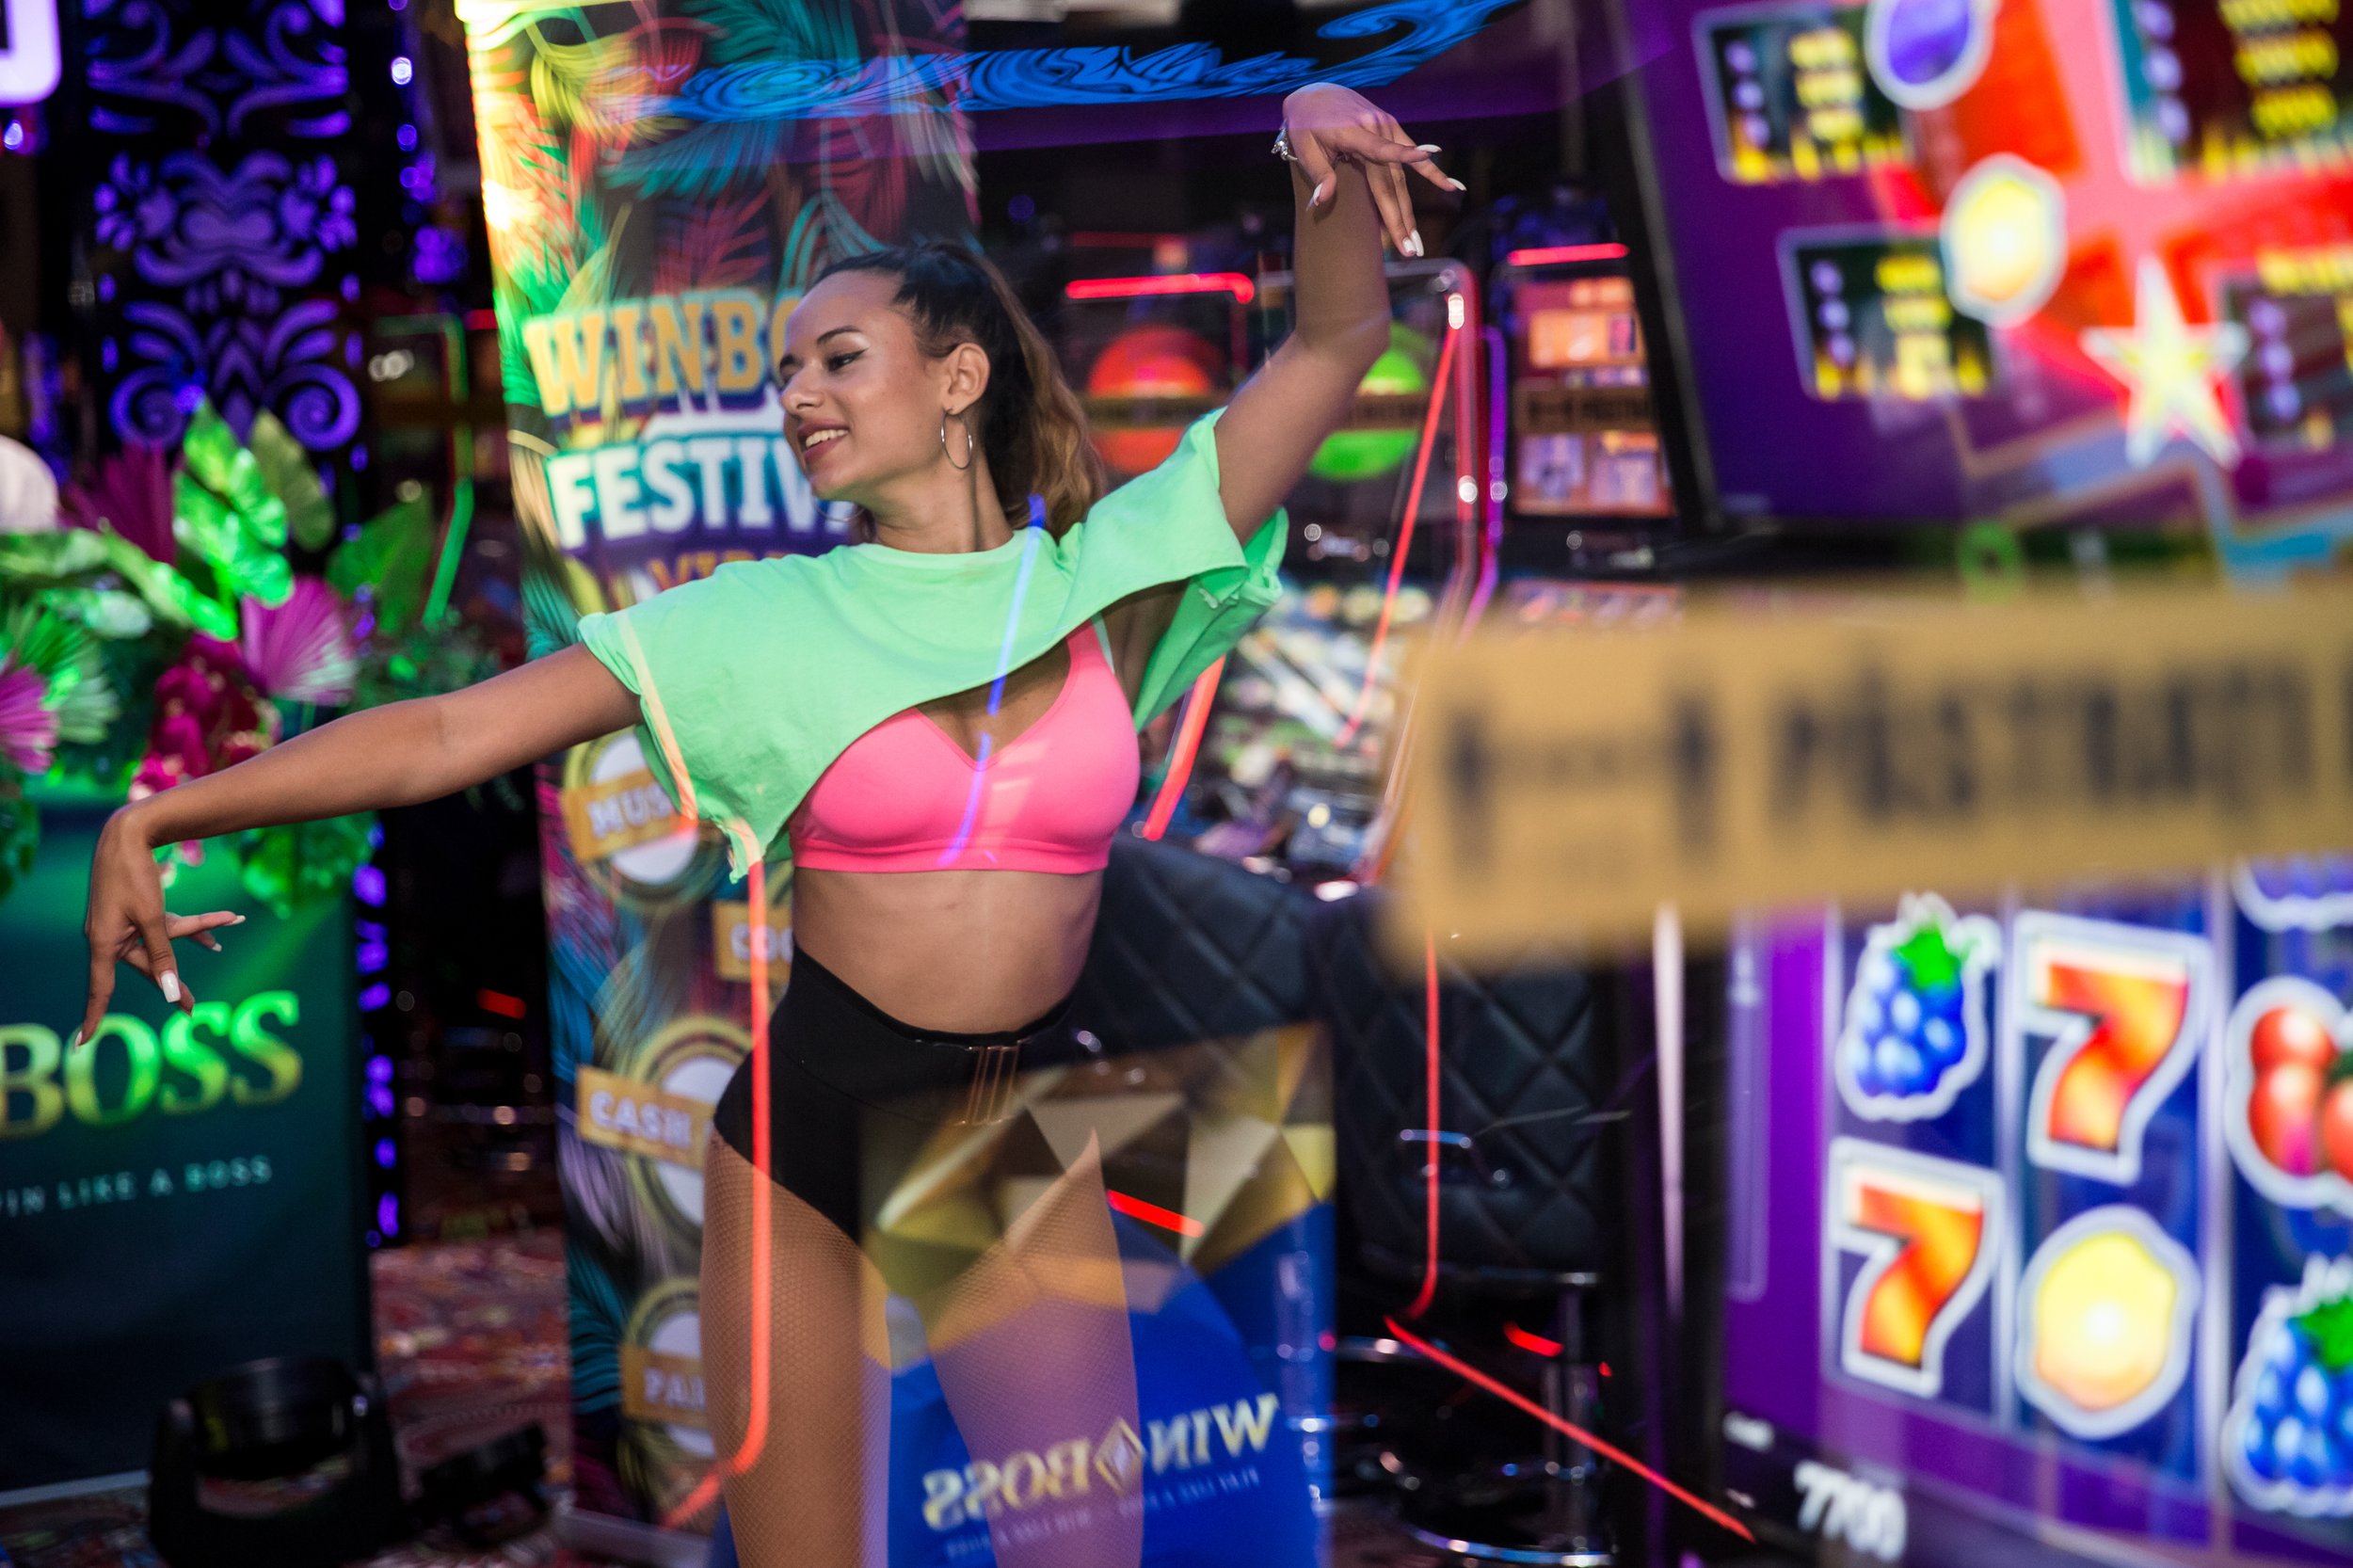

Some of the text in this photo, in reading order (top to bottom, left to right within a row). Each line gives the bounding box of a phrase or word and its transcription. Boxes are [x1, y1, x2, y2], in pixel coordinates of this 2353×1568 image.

[546, 435, 855, 550] FESTIV
[0, 990, 303, 1141] BOSS
[2024, 918, 2202, 1176] 7
[149, 1167, 174, 1197] A
[184, 1154, 274, 1192] BOSS
[588, 1090, 693, 1149] CASH
[1835, 1144, 1997, 1389] 7
